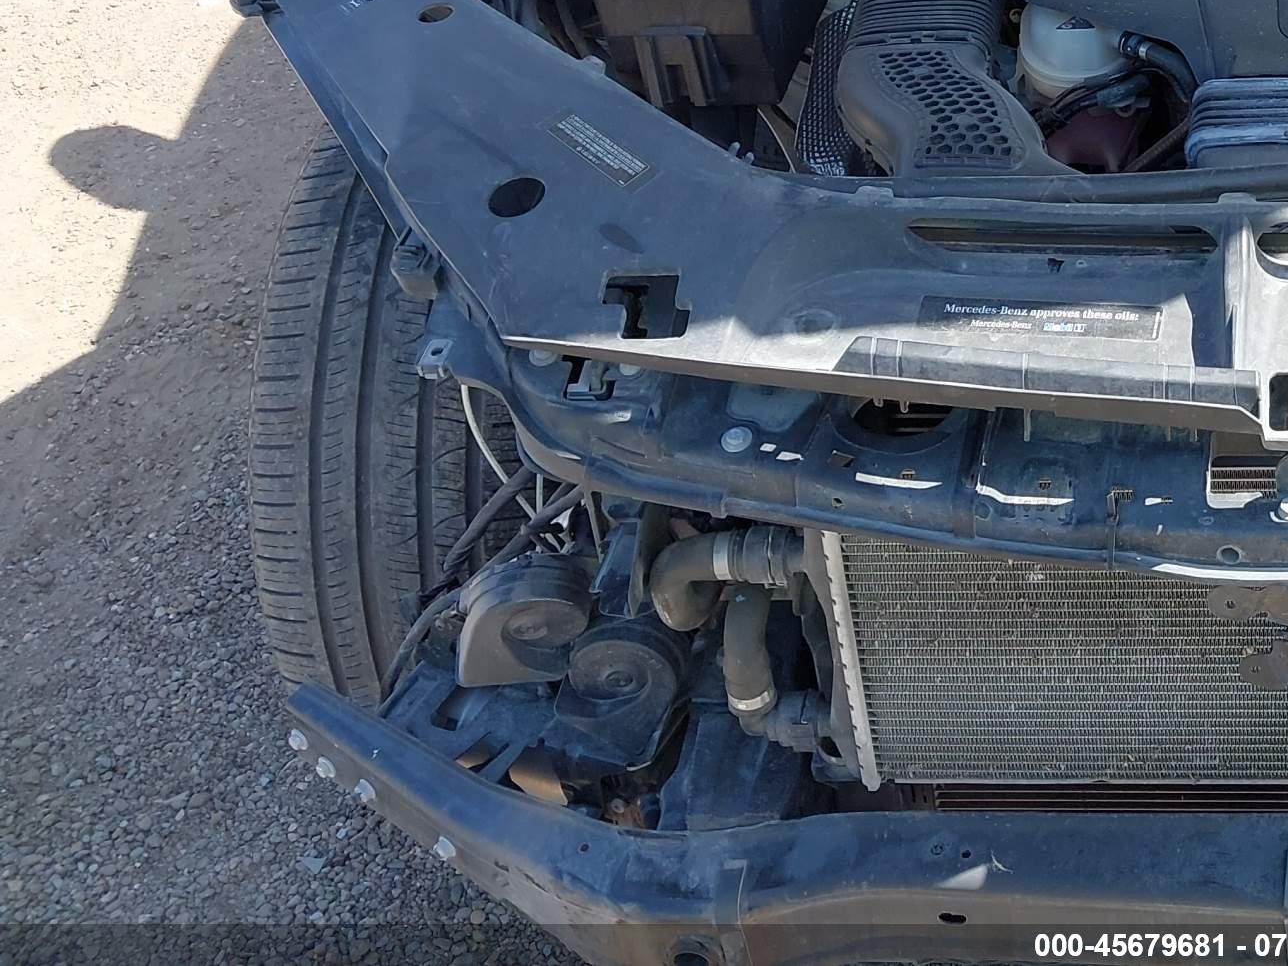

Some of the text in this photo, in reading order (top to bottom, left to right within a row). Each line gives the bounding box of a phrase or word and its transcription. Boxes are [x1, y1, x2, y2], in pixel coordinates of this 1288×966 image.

[943, 303, 1139, 321] Mercedes-Benz approves these oils:
[970, 319, 1032, 330] Mercedes-Benz
